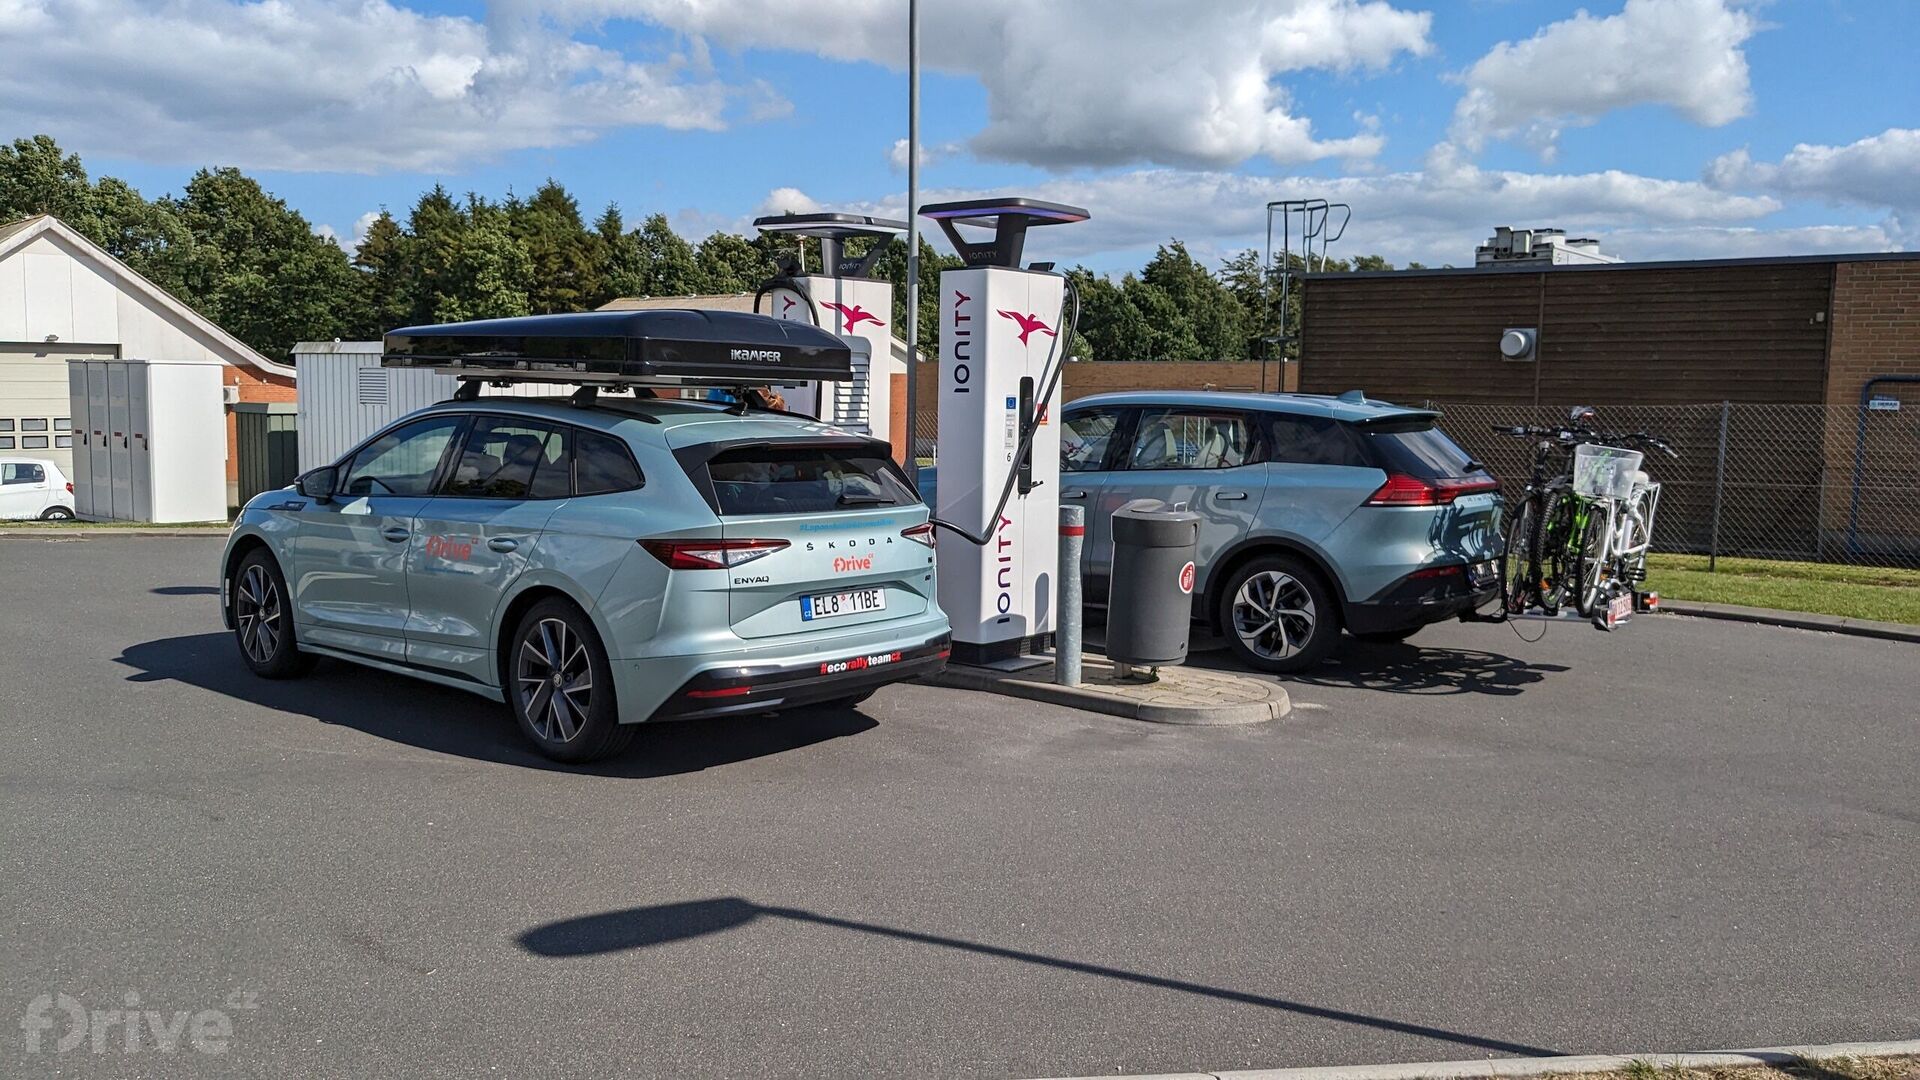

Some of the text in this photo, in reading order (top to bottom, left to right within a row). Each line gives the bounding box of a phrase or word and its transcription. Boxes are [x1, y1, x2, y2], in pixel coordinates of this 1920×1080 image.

[953, 290, 971, 393] IONITY
[1006, 452, 1012, 462] 6
[734, 575, 770, 585] ENYAQ
[997, 514, 1012, 624] IONITY
[814, 595, 840, 616] EL8
[849, 590, 880, 611] 11BE
